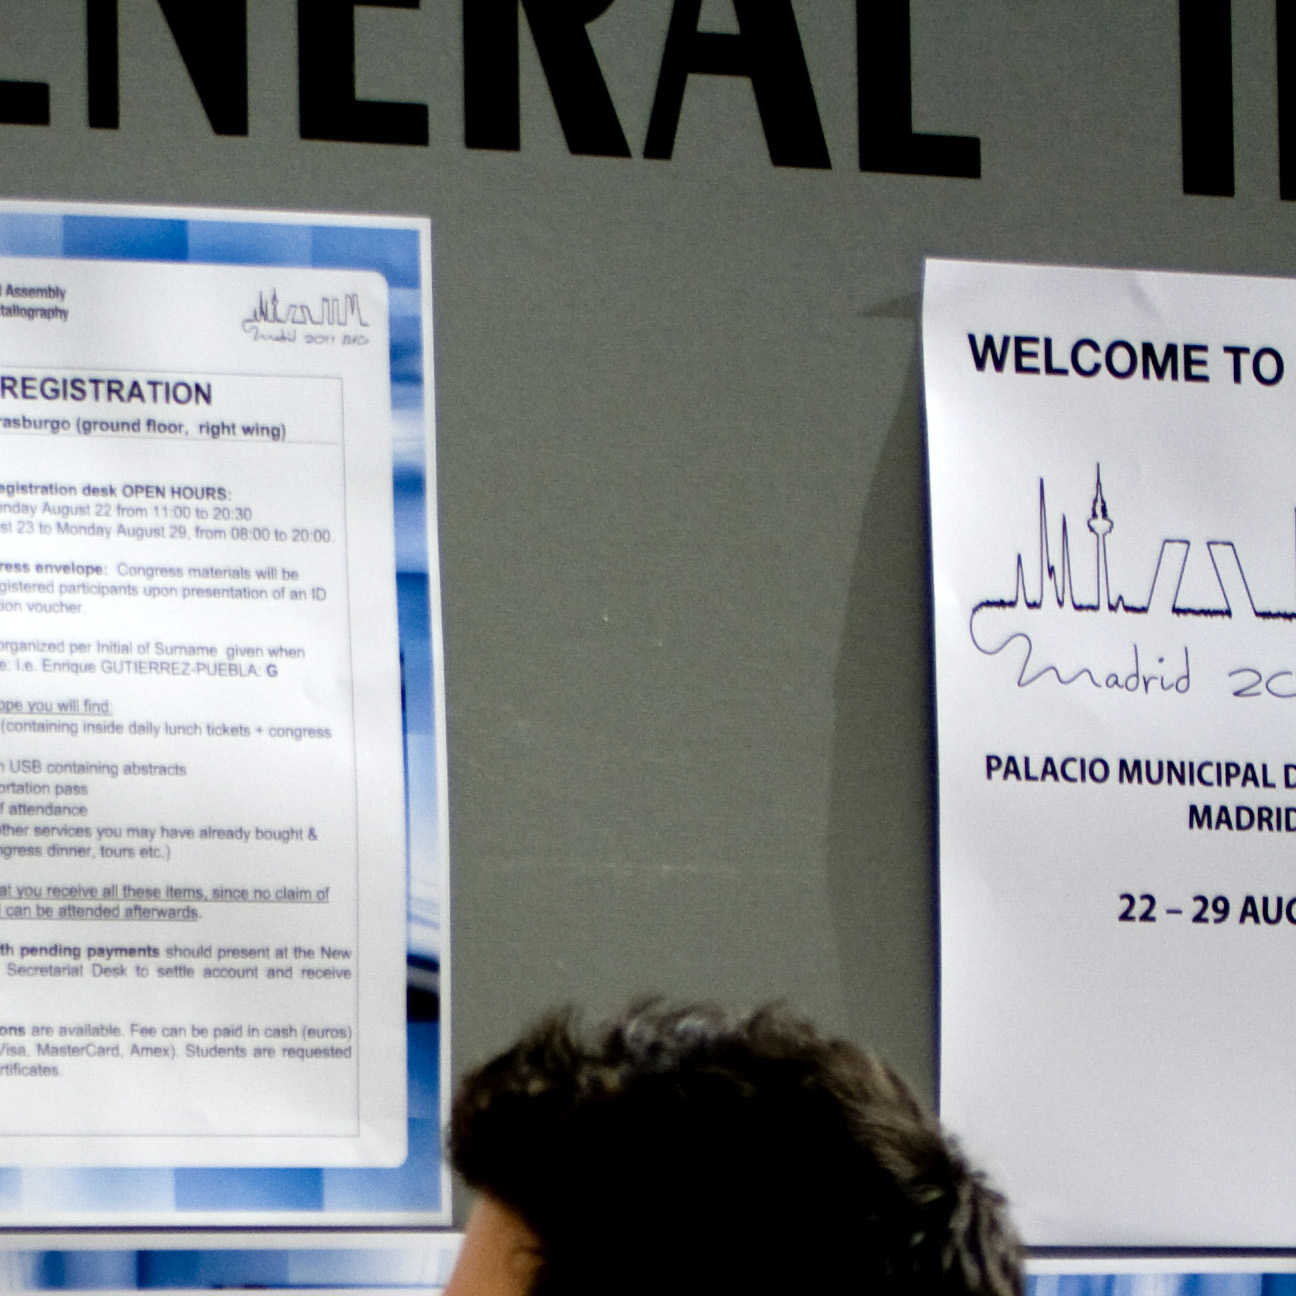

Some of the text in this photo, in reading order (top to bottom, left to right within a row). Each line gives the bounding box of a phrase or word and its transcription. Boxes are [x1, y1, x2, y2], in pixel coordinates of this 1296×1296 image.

[967, 333, 1285, 386] WELCOME TO
[75, 416, 141, 437] (ground
[198, 420, 236, 440] right
[241, 421, 287, 442] wing)
[82, 483, 116, 497] desk
[122, 484, 165, 499] OPEN
[40, 502, 91, 520] August
[94, 503, 112, 517] 22
[114, 503, 148, 518] from
[151, 504, 192, 519] 11:00
[194, 505, 209, 519] to
[1016, 641, 1192, 696] Madrid
[986, 755, 1110, 784] PALACIO
[1118, 758, 1276, 788] MUNICIPAL
[1188, 804, 1296, 832] MADRID
[1118, 893, 1157, 923] 22
[1191, 895, 1230, 924] 29
